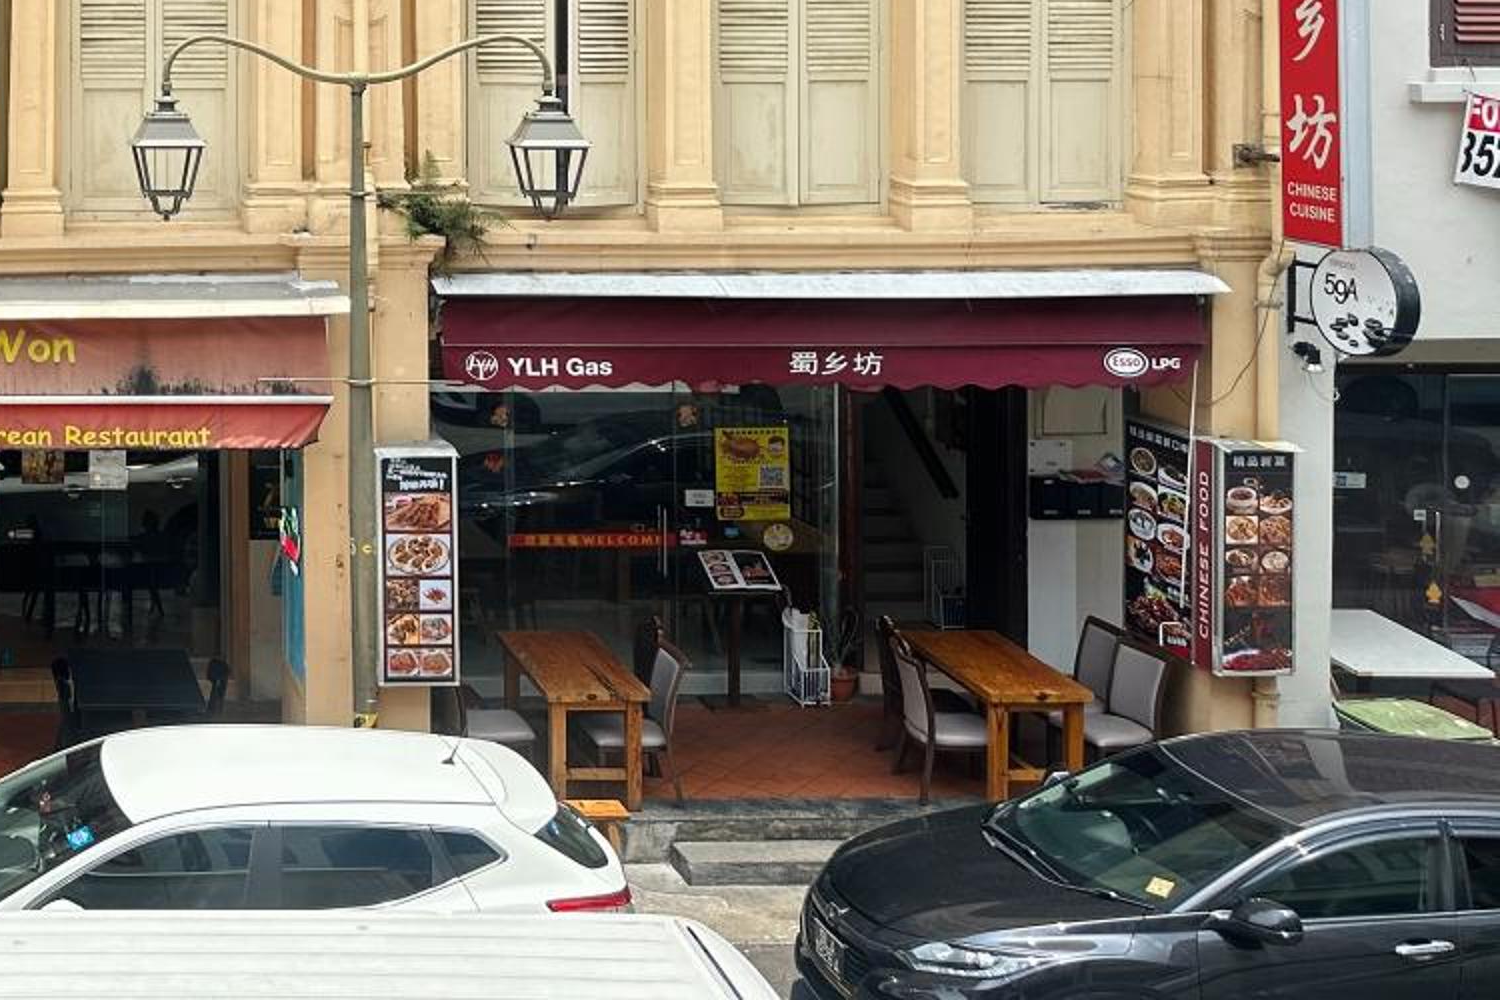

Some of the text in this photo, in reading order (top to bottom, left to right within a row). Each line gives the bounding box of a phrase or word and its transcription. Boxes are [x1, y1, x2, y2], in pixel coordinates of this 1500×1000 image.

[1287, 181, 1338, 202] CHINESE
[1289, 202, 1336, 223] CUISINE
[507, 357, 613, 377] YLH Gas
[789, 351, 883, 375] 蜀乡坊
[1151, 357, 1182, 370] LPG
[64, 424, 211, 447] Restaurant
[1199, 471, 1210, 640] CHINESE FOOD
